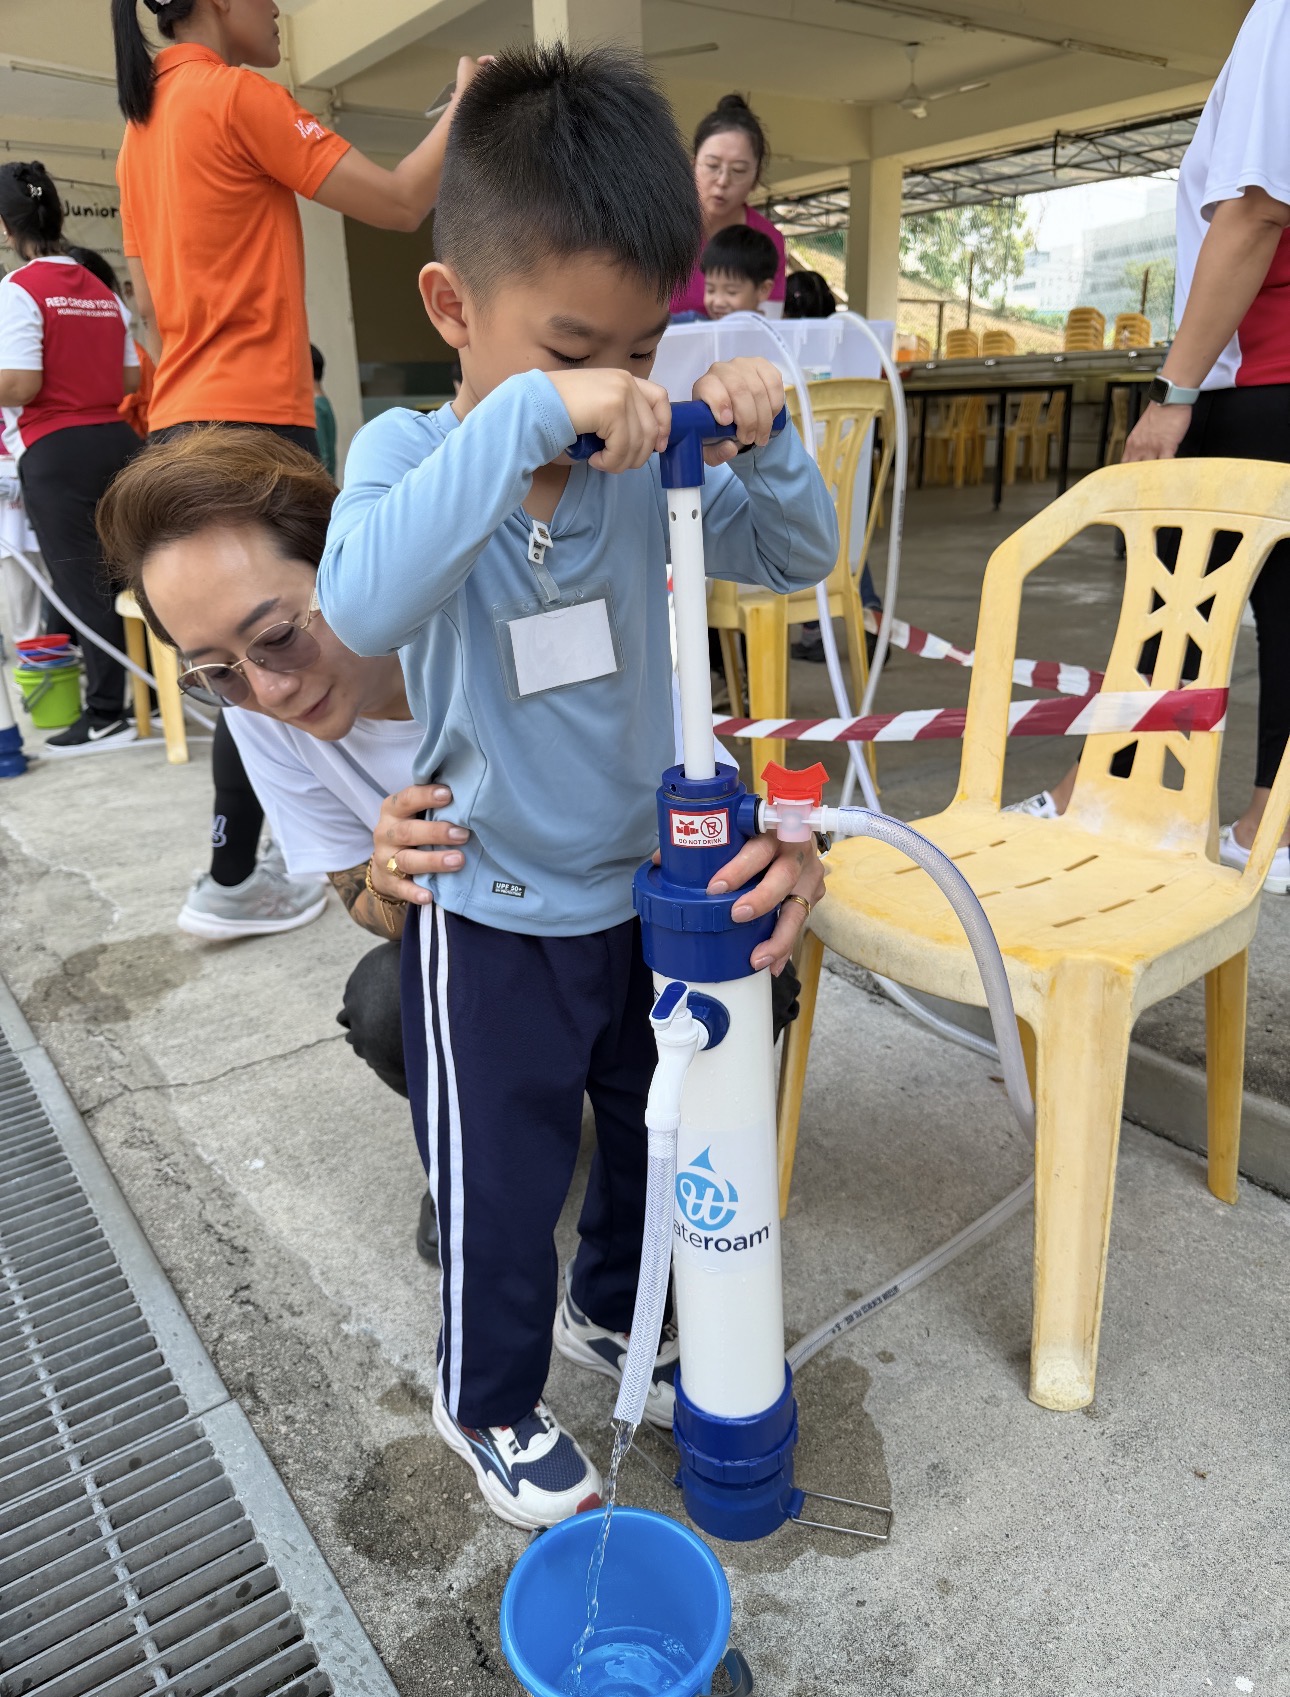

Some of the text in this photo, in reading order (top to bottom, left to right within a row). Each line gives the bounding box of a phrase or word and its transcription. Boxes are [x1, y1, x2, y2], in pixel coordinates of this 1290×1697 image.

[63, 200, 119, 218] Junior
[45, 296, 68, 308] RED
[68, 297, 96, 309] CROSS
[496, 882, 510, 891] UPF
[673, 1218, 770, 1253] ateroam
